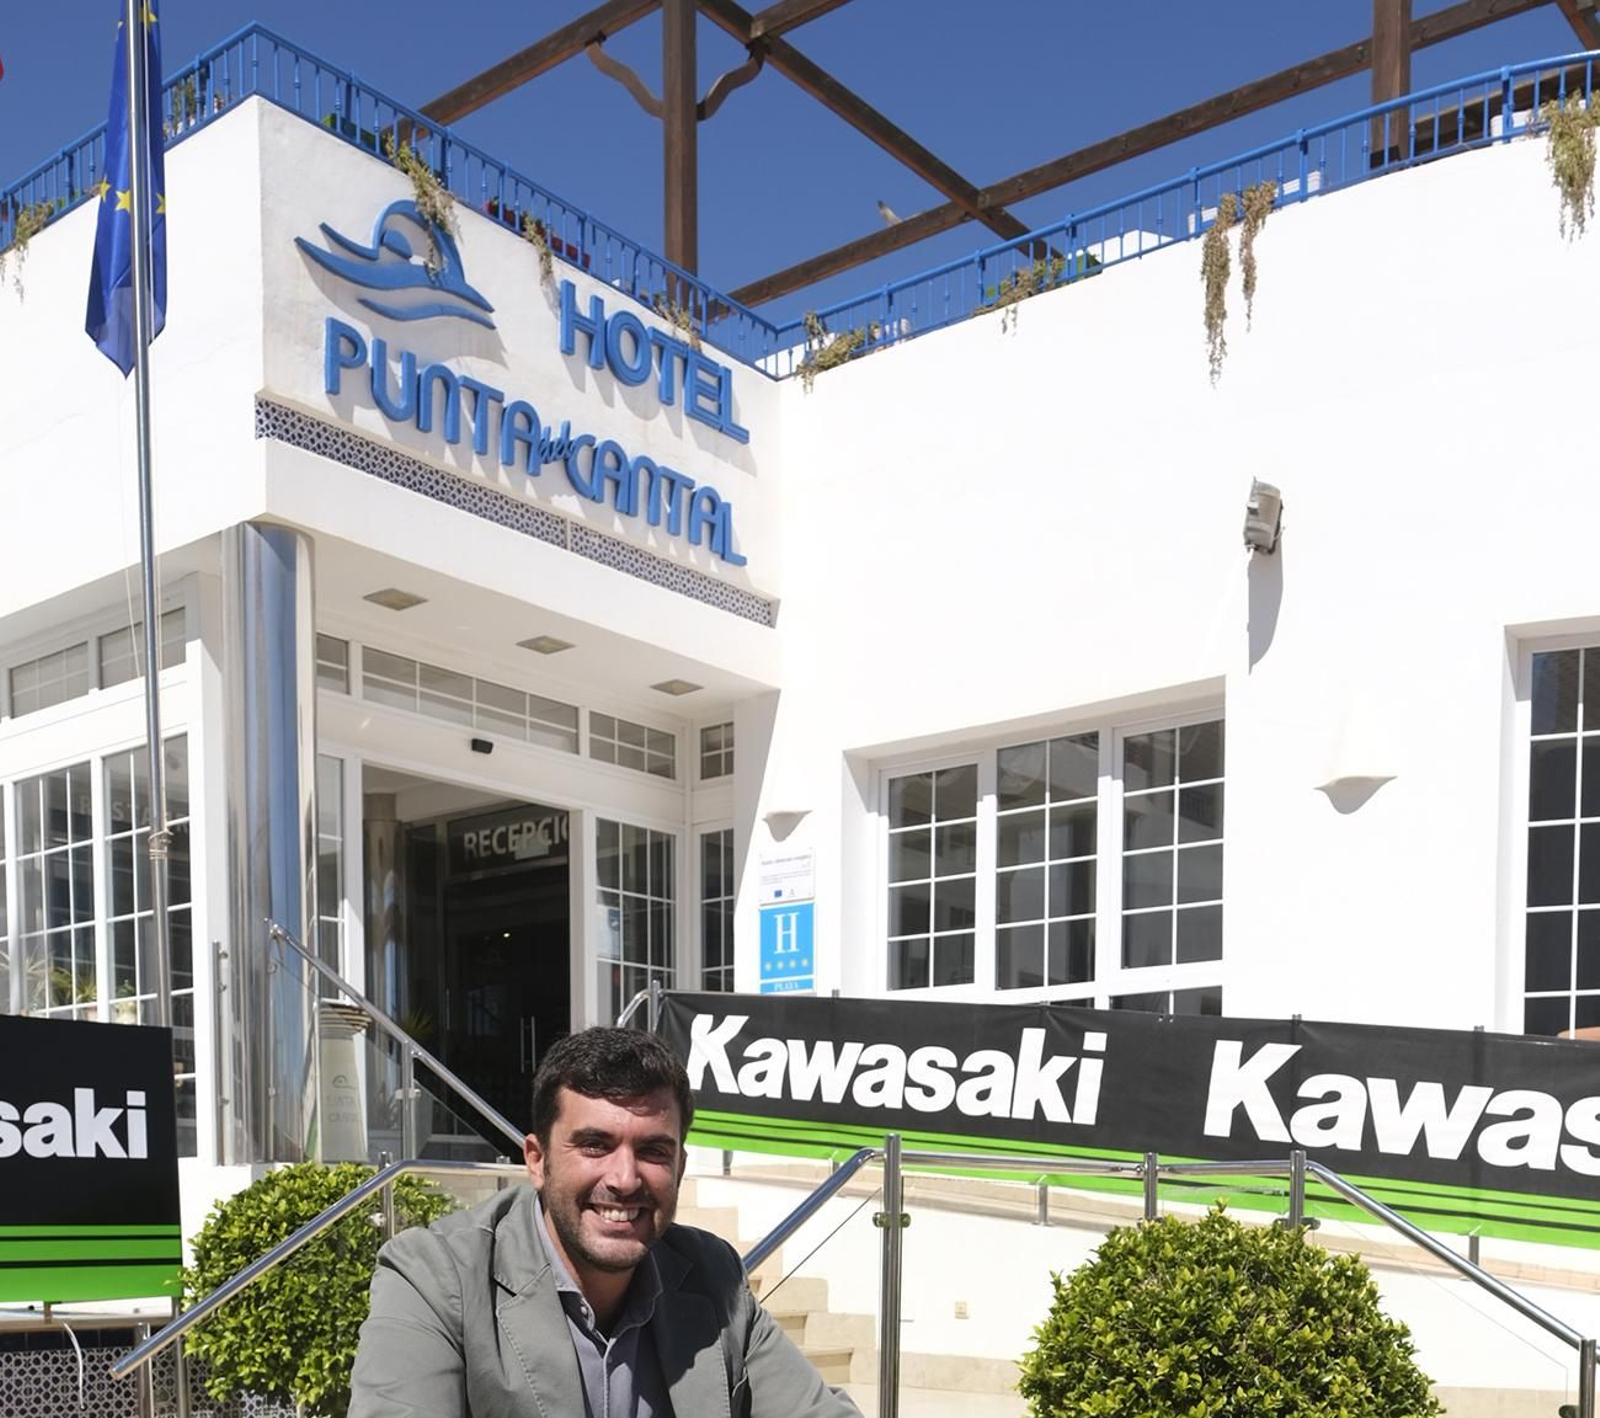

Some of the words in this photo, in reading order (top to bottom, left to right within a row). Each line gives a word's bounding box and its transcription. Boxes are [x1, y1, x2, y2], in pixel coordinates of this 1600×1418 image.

[560, 279, 749, 444] HOTEL
[325, 317, 541, 477] PUNTA
[537, 421, 575, 465] del
[566, 433, 747, 566] CANTAL
[774, 912, 800, 954] H
[686, 1014, 1107, 1125] Kawasaki
